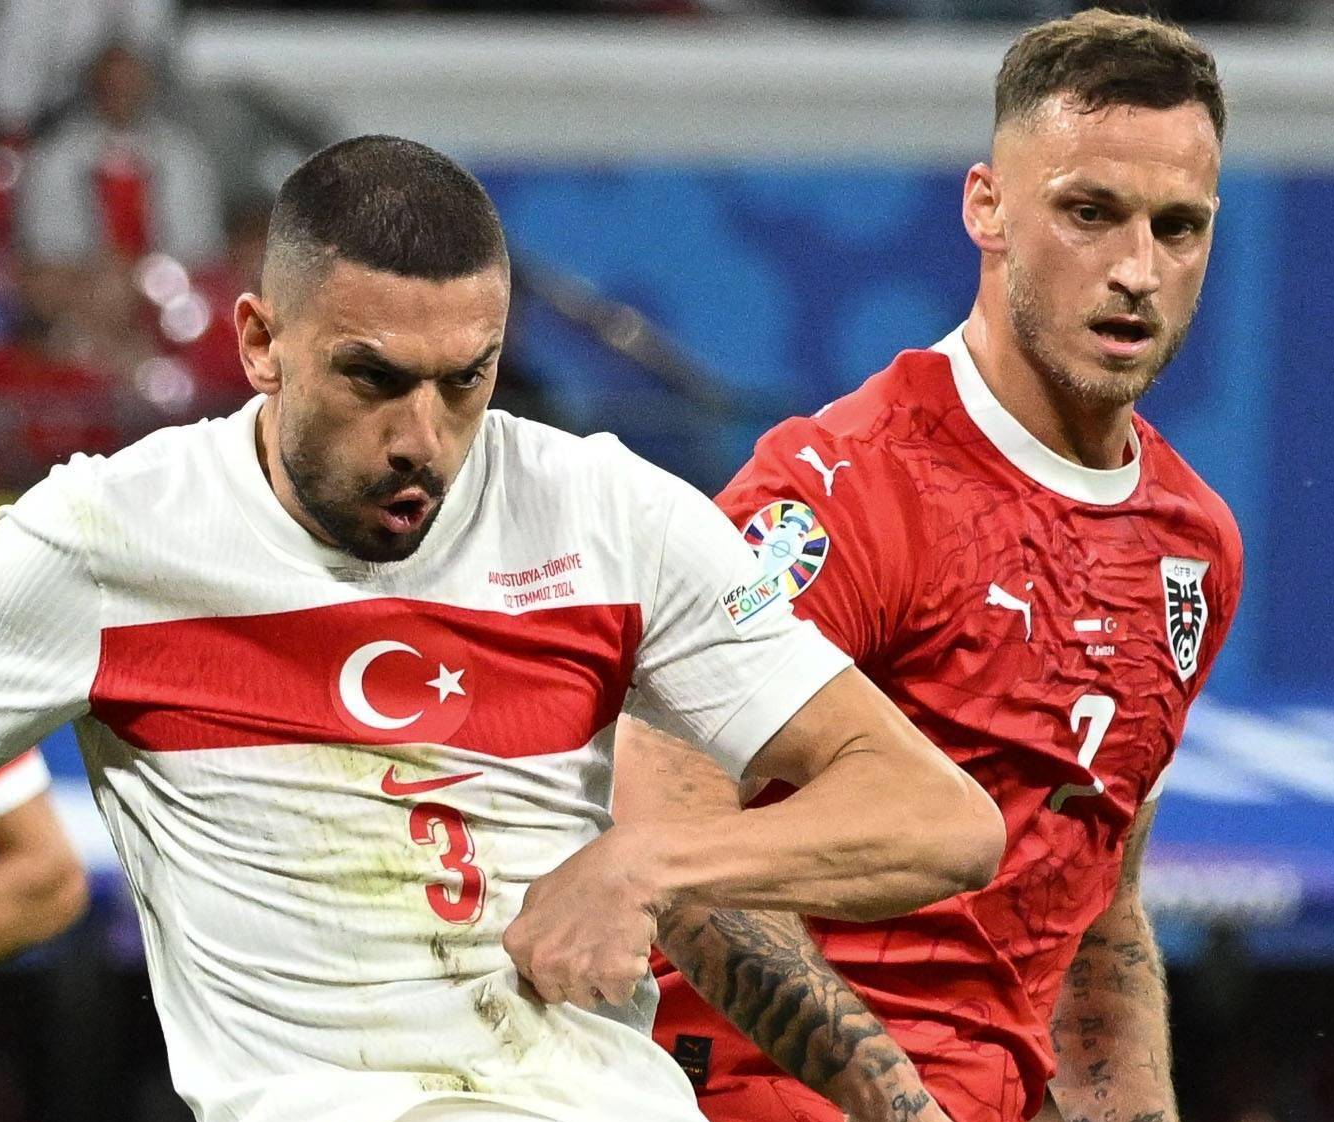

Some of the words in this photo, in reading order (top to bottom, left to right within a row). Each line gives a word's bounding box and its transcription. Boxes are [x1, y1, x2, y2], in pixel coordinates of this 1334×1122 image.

[514, 586, 552, 609] TEMMUZ
[552, 580, 575, 599] 2024
[722, 584, 747, 606] UEFA
[1057, 694, 1115, 800] 7
[408, 802, 487, 926] 3
